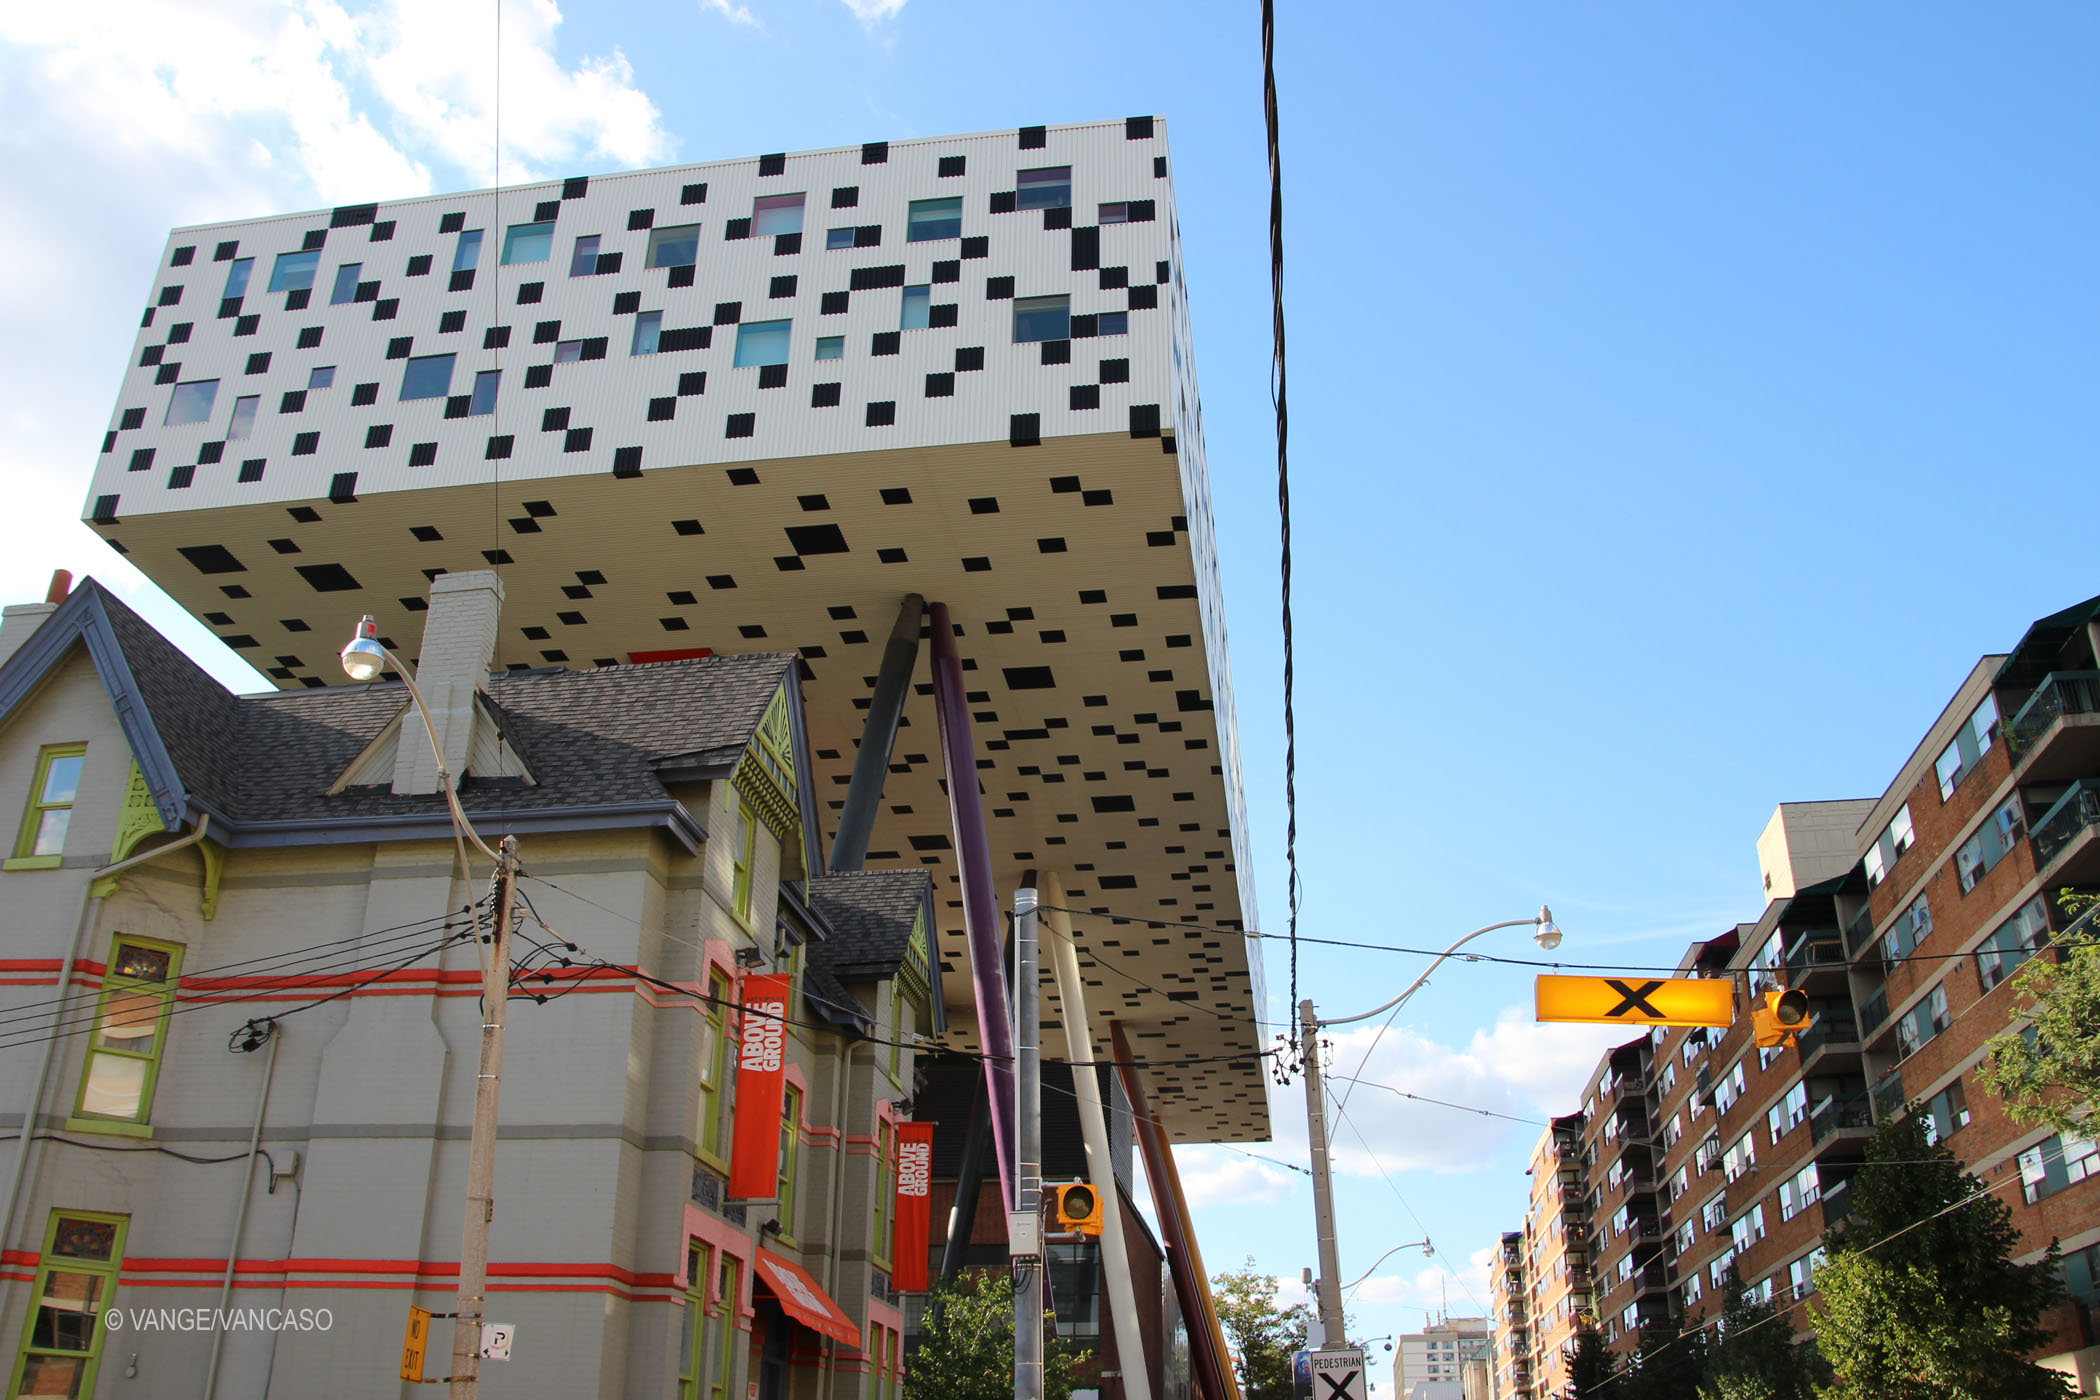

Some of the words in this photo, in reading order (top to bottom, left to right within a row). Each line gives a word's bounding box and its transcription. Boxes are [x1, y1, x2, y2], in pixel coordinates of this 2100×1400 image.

[1603, 979, 1667, 1018] X
[741, 1002, 768, 1072] ABOVE
[763, 1001, 784, 1072] GROUND
[898, 1143, 917, 1196] ABOVE
[914, 1143, 930, 1197] GROUND
[410, 1318, 421, 1340] NO
[404, 1348, 420, 1371] EXIT
[1314, 1356, 1361, 1369] PEDESTRIAN
[1317, 1370, 1359, 1400] X
